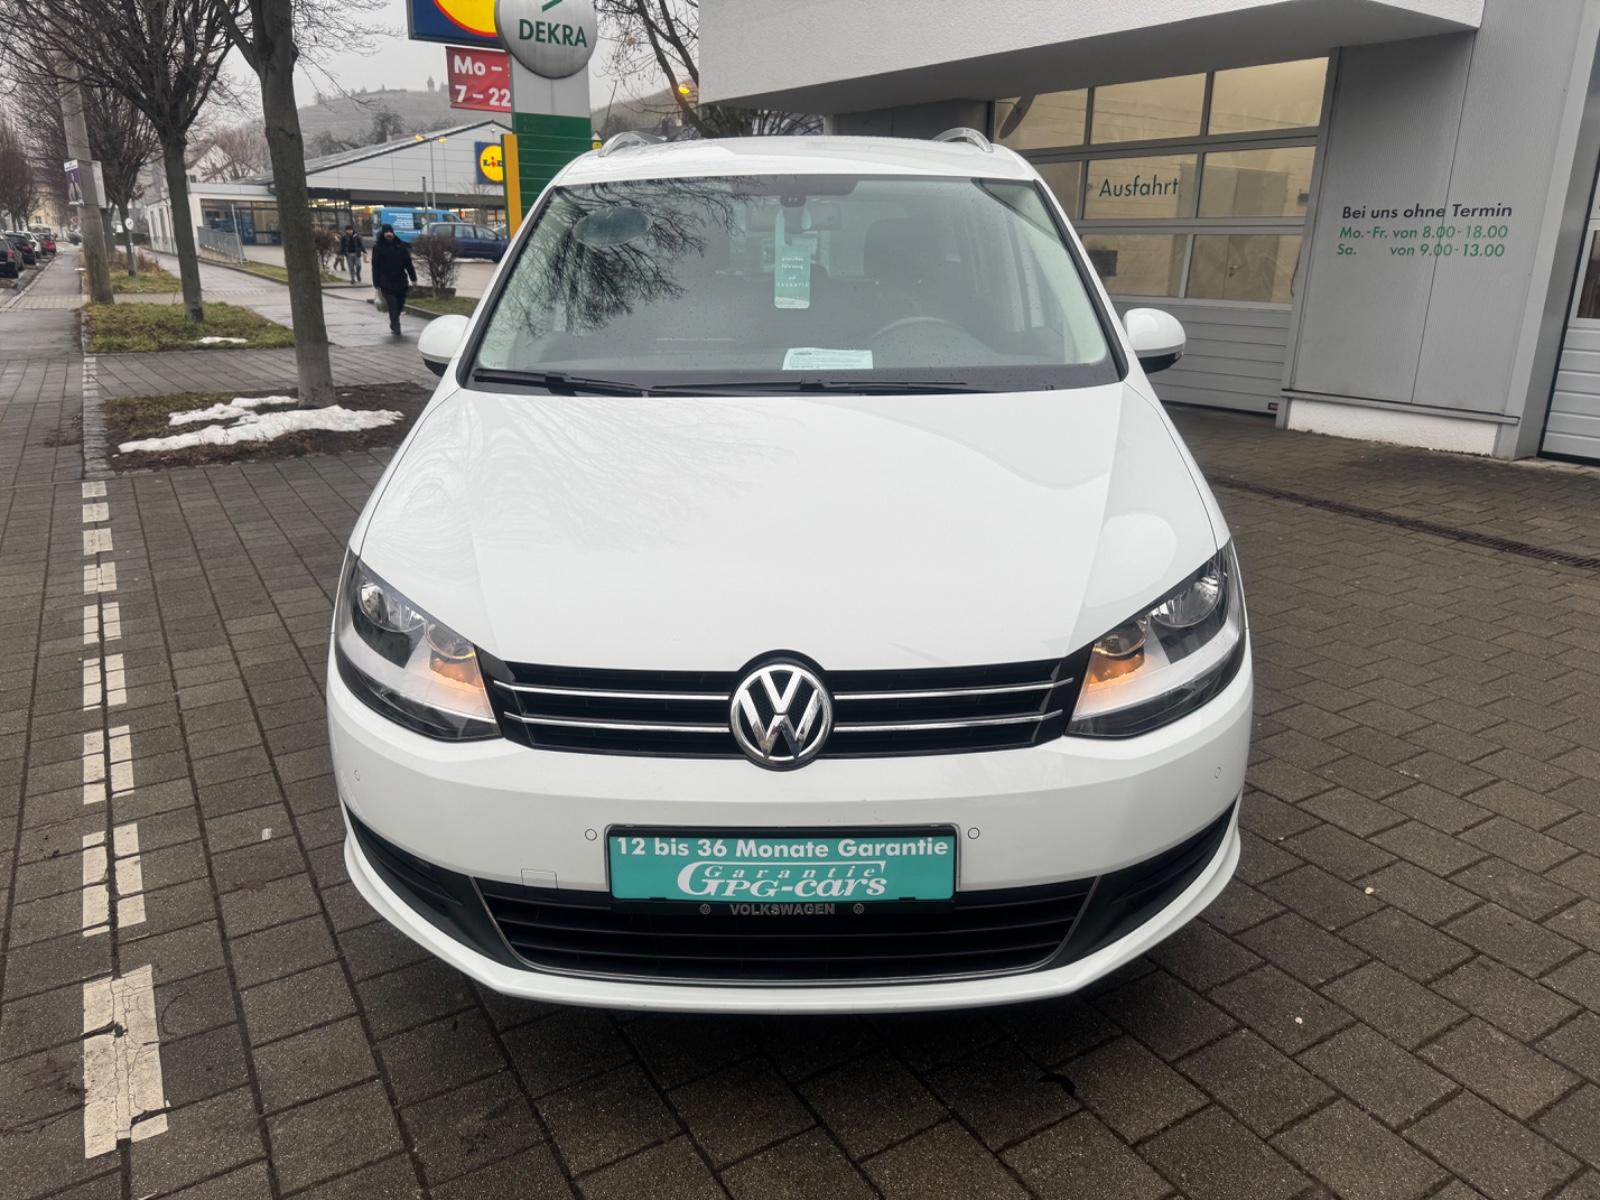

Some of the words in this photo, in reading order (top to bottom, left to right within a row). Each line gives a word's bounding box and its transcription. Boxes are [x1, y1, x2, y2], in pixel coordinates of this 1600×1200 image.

[519, 18, 588, 48] DEKRA
[454, 54, 486, 76] Mo
[454, 85, 467, 103] 7
[488, 87, 511, 107] 22
[1098, 174, 1180, 198] Ausfahrt
[1341, 205, 1367, 219] Bei
[1370, 207, 1398, 219] uns
[1403, 203, 1446, 219] ohne
[1452, 202, 1512, 218] Termin
[1392, 228, 1418, 239] von
[1336, 243, 1357, 256] Sa.
[1390, 246, 1415, 257] von
[730, 664, 832, 762] VW
[616, 837, 646, 856] 12
[654, 837, 689, 857] bis
[697, 838, 727, 858] 36
[735, 839, 829, 858] Monate
[837, 837, 949, 857] Garantie
[677, 860, 888, 897] GPG-cars
[704, 865, 875, 879] Garantie
[730, 903, 836, 916] VOLKSWAGEN
